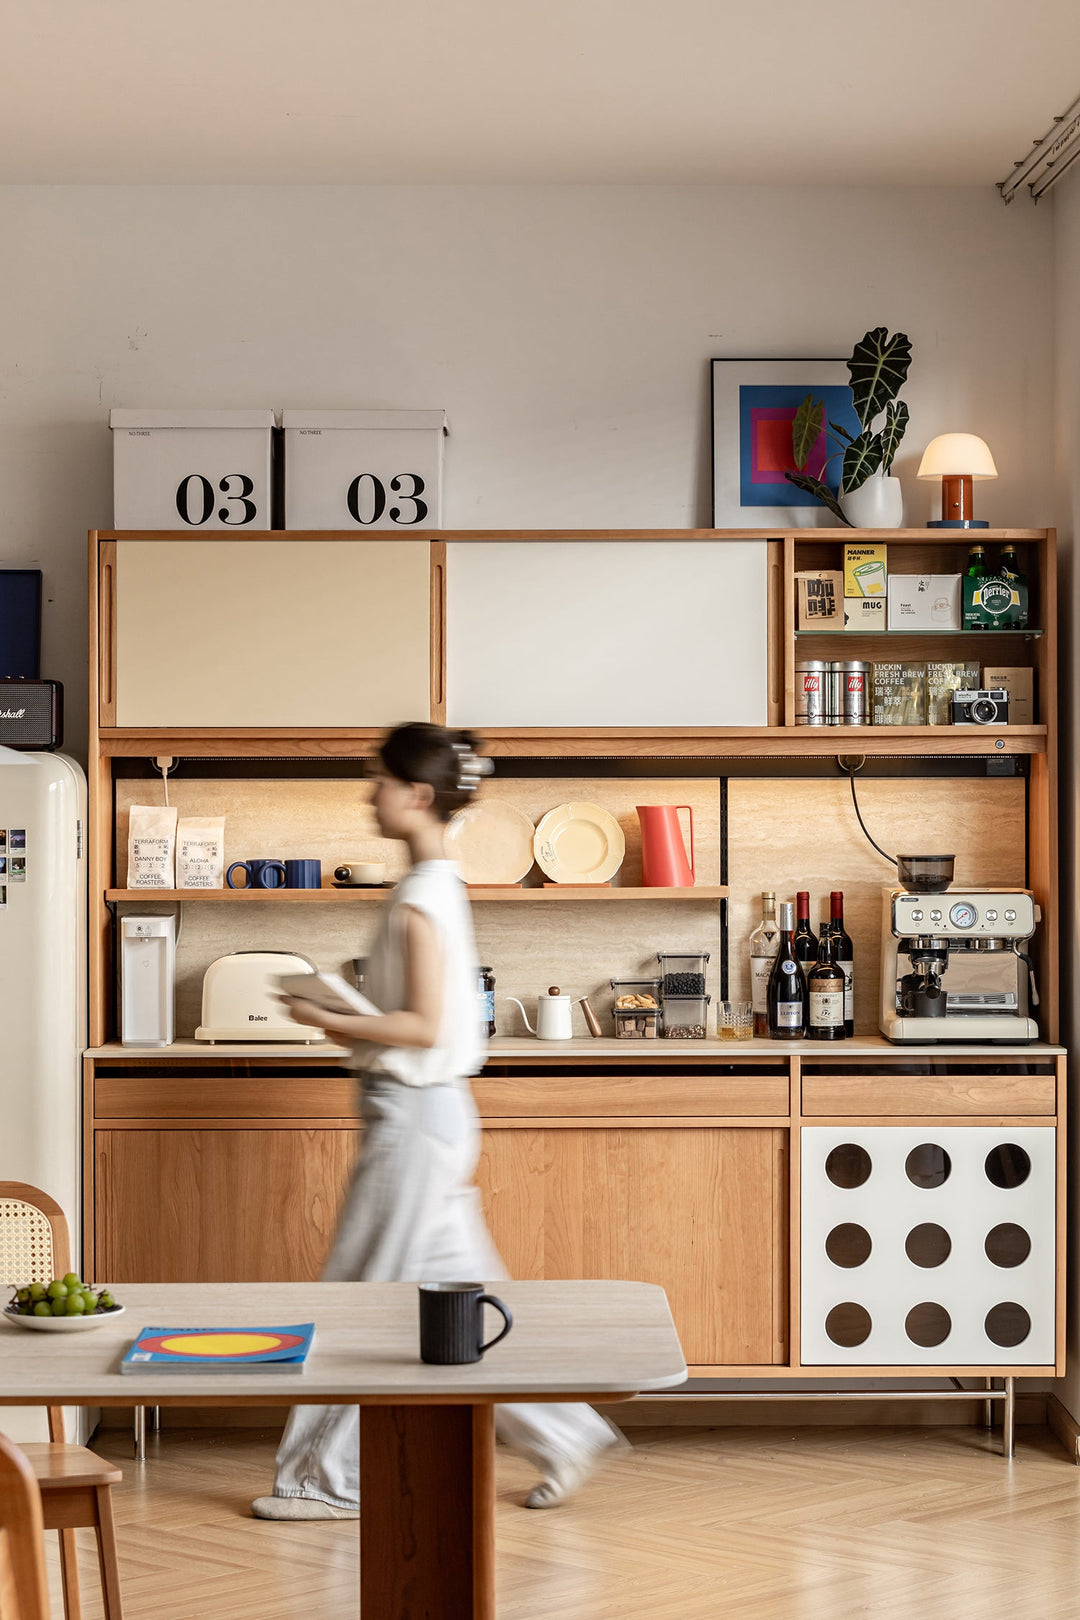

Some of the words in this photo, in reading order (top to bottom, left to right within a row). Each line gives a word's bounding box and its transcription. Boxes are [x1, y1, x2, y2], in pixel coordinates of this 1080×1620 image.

[175, 473, 257, 526] 03
[347, 473, 428, 525] 03
[862, 601, 882, 610] MUG
[874, 663, 902, 671] LUCKIN
[927, 663, 956, 671] LUCKIN
[805, 678, 819, 690] illy
[848, 678, 862, 690] illy
